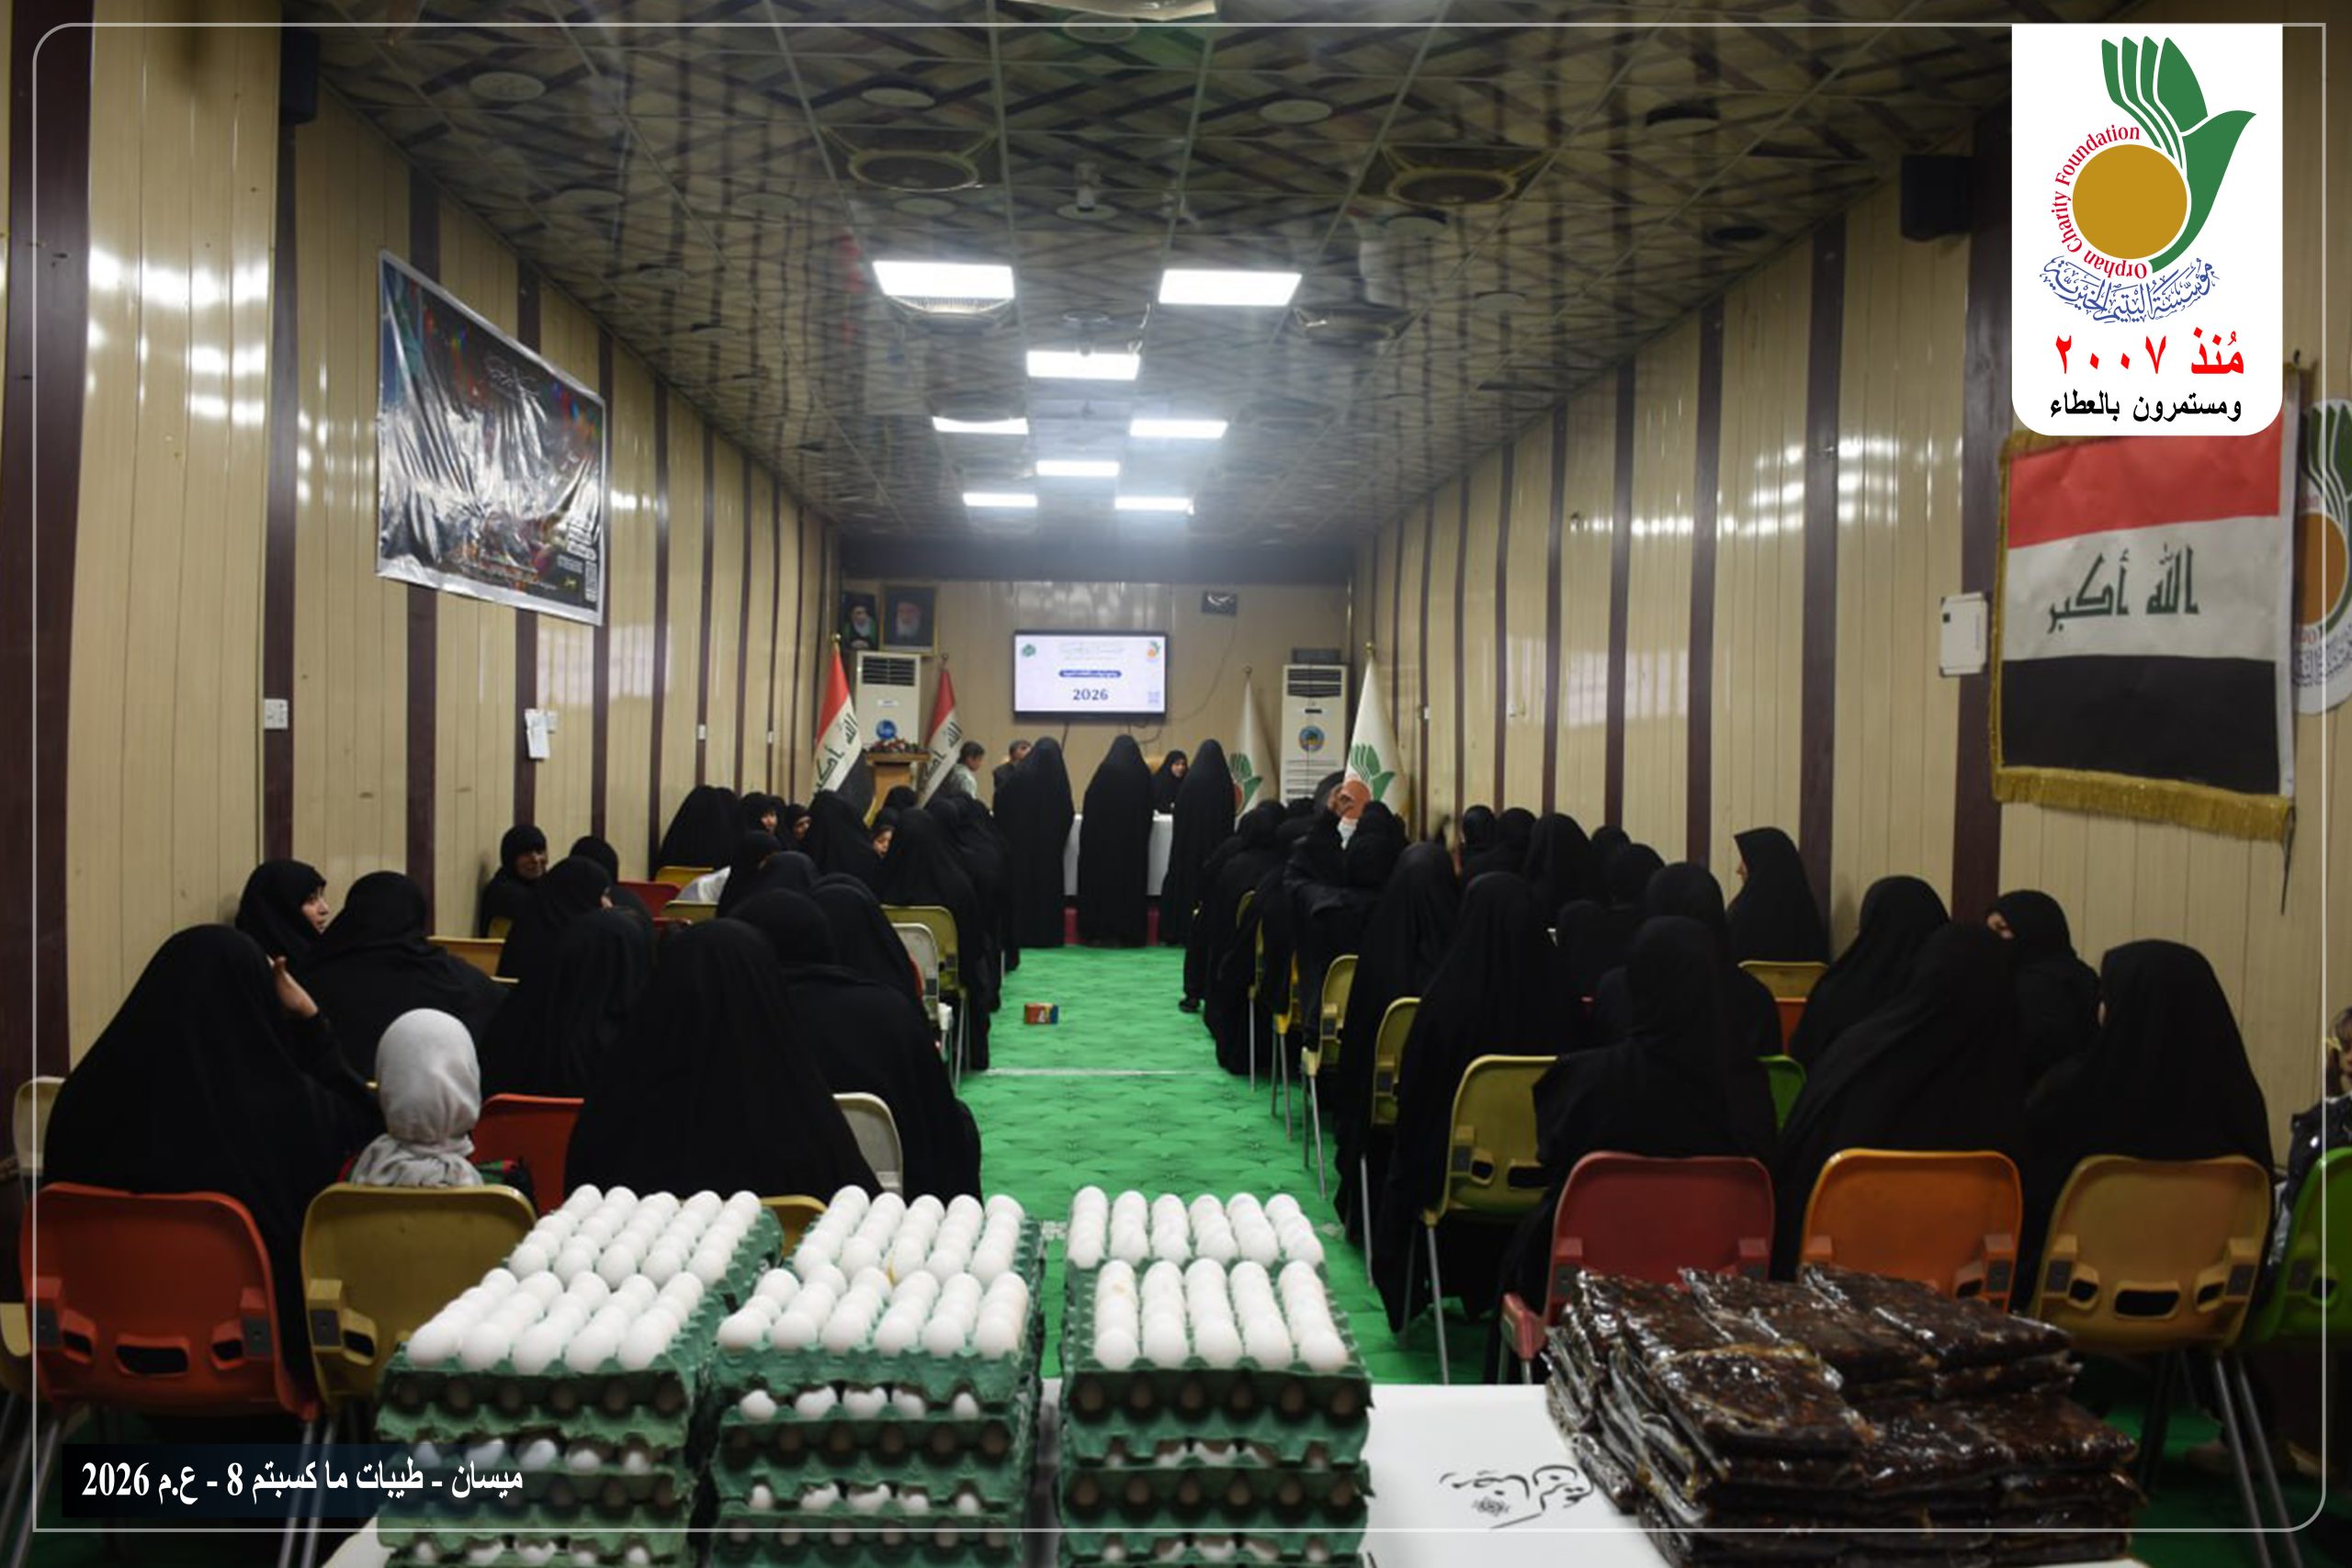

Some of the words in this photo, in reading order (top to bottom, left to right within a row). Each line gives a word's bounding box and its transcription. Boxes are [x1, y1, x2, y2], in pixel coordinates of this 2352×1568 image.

[2047, 548, 2130, 635] أكبر
[2145, 543, 2199, 615] الله
[1072, 688, 1109, 701] 2026
